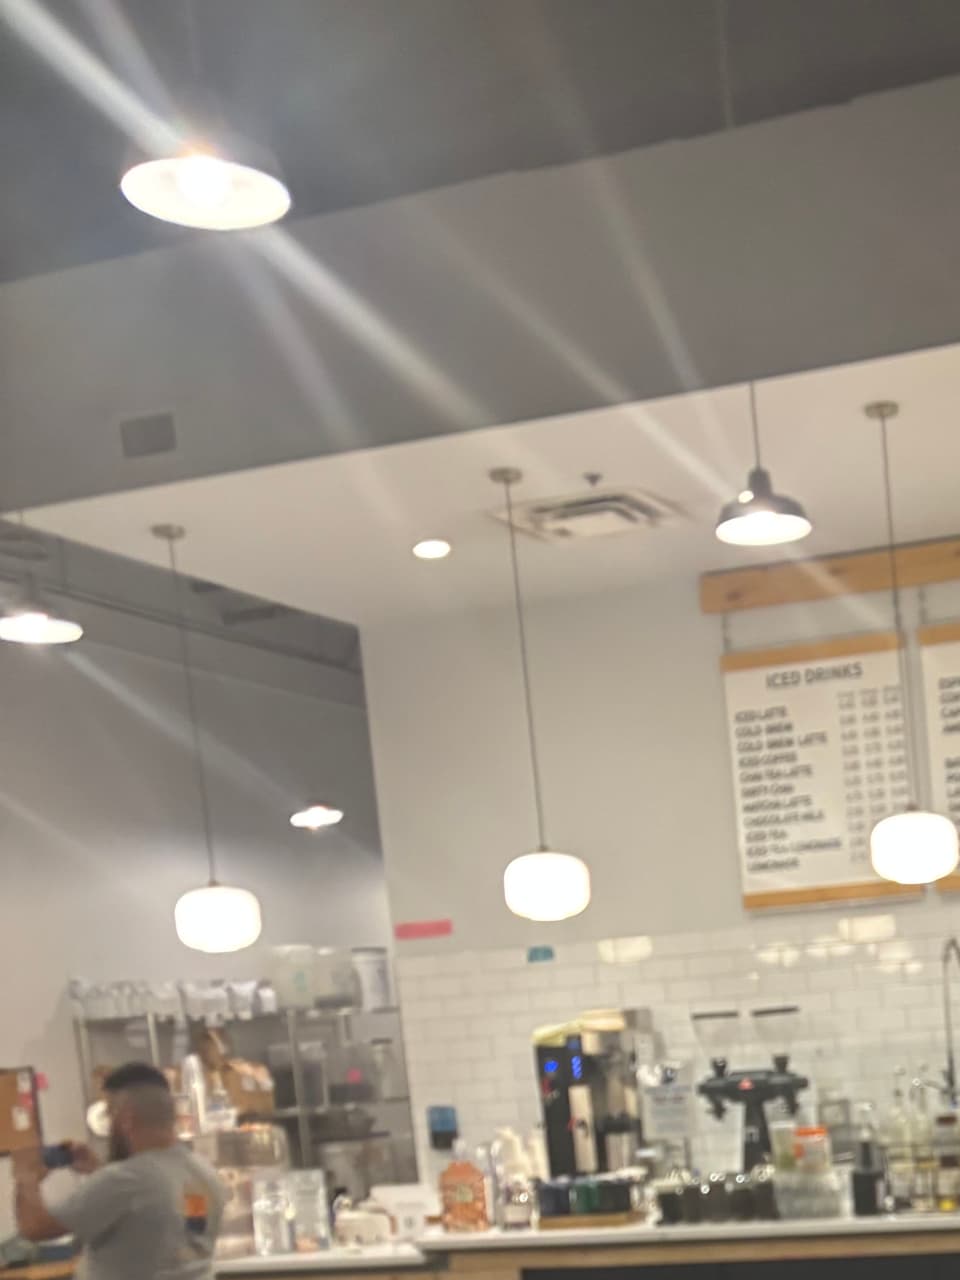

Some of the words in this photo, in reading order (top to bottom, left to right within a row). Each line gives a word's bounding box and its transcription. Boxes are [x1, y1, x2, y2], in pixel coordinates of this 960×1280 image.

[766, 670, 801, 688] ICED
[805, 662, 862, 684] DRINKS
[735, 725, 762, 738] COLD
[765, 722, 793, 733] BREW
[737, 740, 763, 753] COLD
[767, 738, 794, 749] BREW
[798, 731, 828, 745] LATTE
